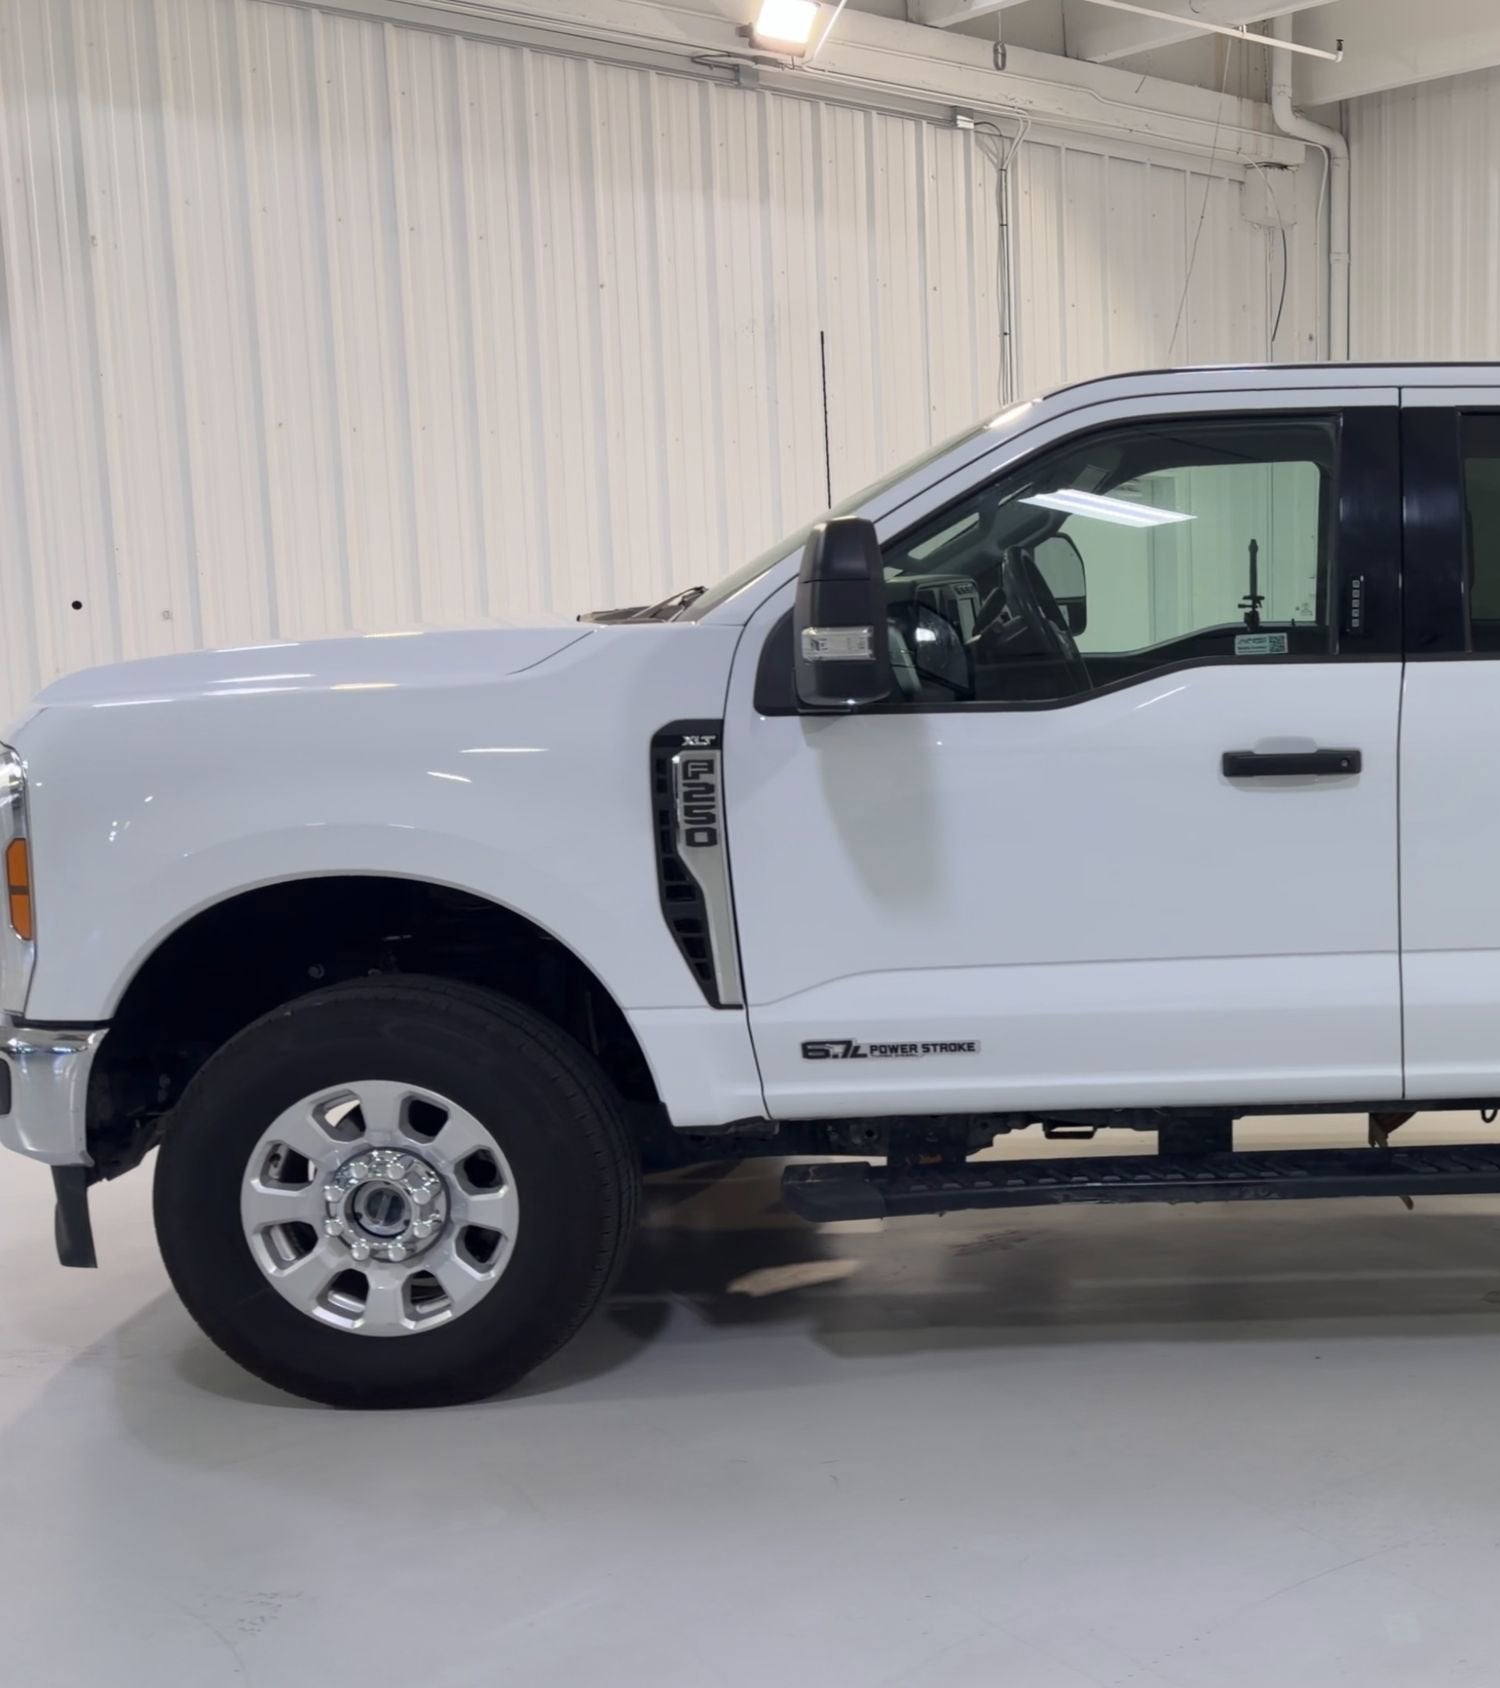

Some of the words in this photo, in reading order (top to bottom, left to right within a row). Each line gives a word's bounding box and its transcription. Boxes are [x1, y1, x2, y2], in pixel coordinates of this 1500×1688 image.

[681, 735, 717, 746] XLT
[682, 759, 718, 848] F250
[801, 1040, 868, 1060] 6.7L
[869, 1043, 919, 1055] POWER
[921, 1041, 976, 1053] STROKE
